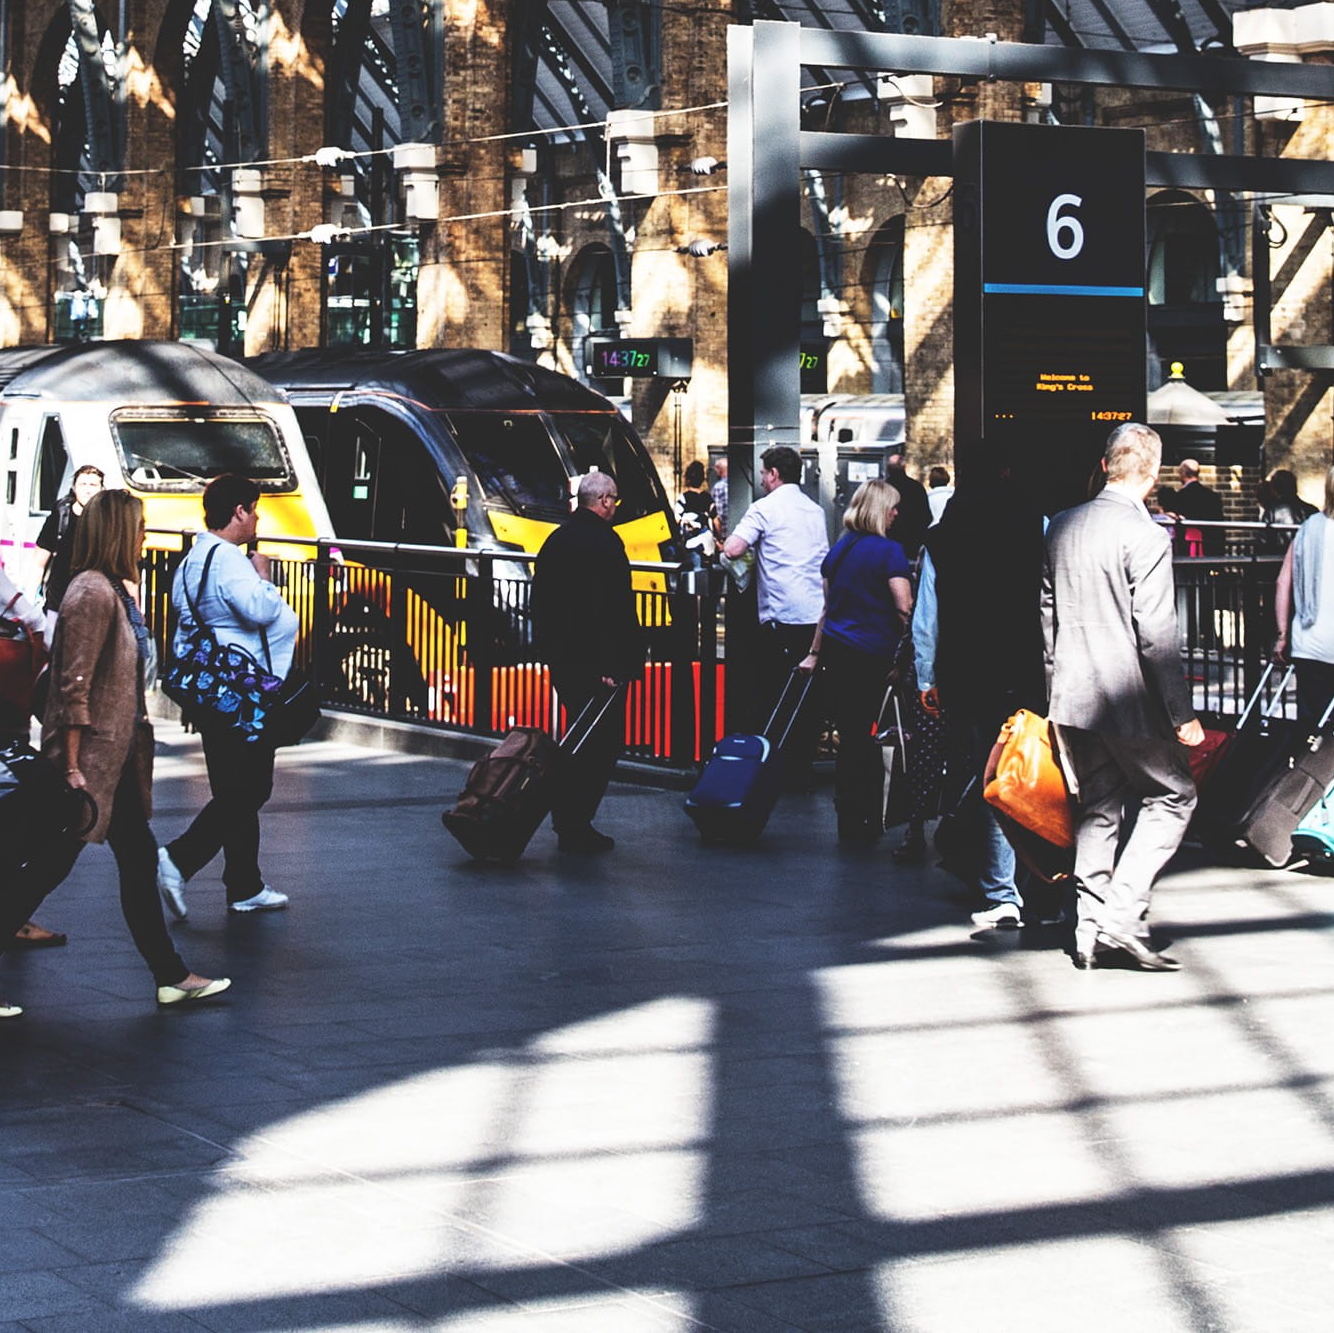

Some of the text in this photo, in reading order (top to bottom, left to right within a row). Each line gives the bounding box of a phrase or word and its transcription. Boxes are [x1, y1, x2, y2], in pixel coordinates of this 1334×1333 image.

[1046, 193, 1084, 260] 6
[1039, 373, 1091, 382] Welcome to
[1035, 382, 1094, 393] King's Cross
